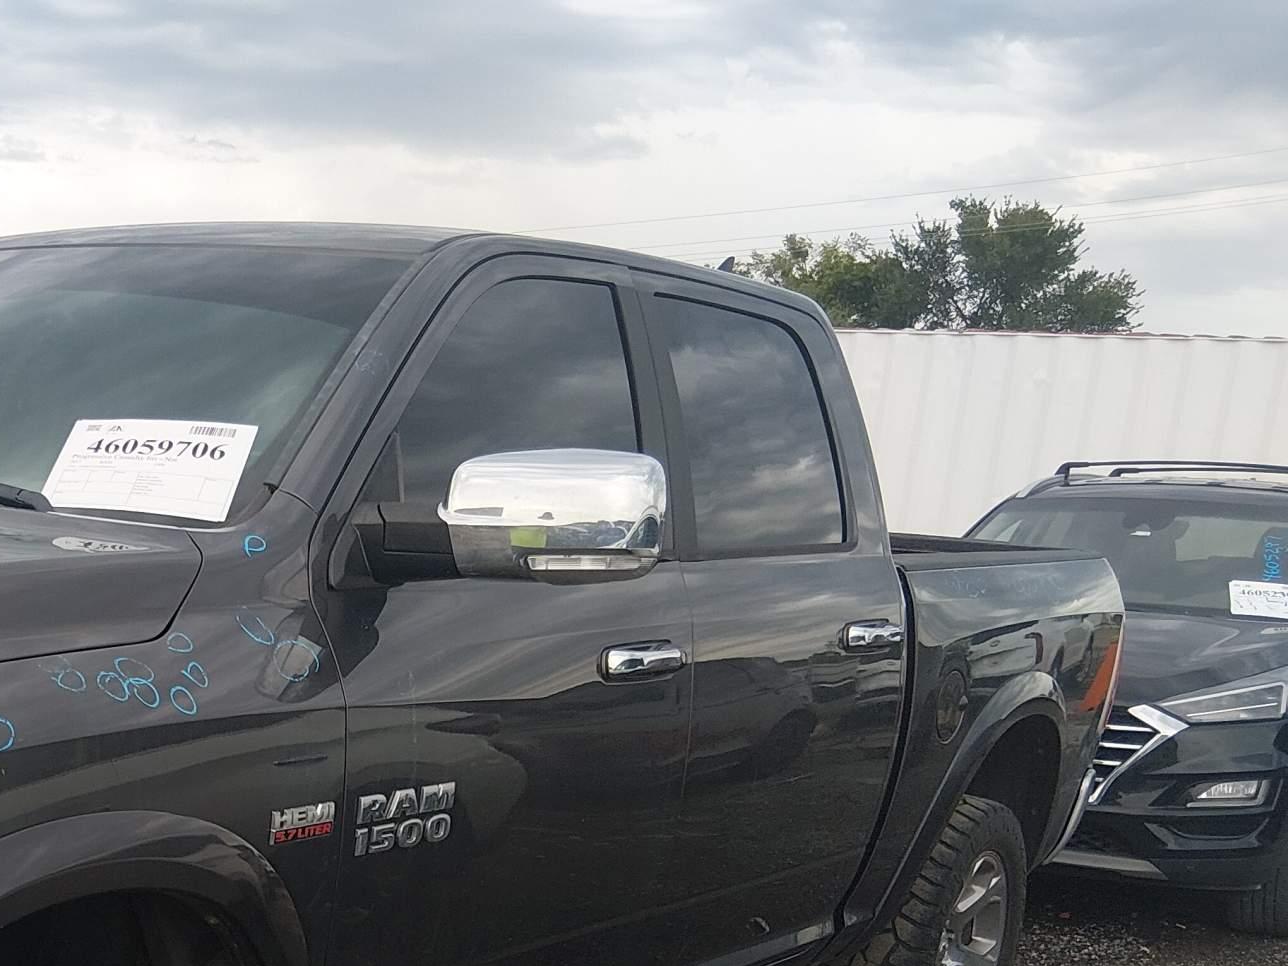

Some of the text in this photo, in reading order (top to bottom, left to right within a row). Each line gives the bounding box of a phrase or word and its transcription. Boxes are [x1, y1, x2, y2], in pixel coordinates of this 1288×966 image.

[87, 438, 228, 461] 46059706
[272, 801, 335, 828] HEMI
[357, 782, 455, 824] RAM
[297, 823, 332, 838] LITER
[354, 813, 451, 856] 1500
